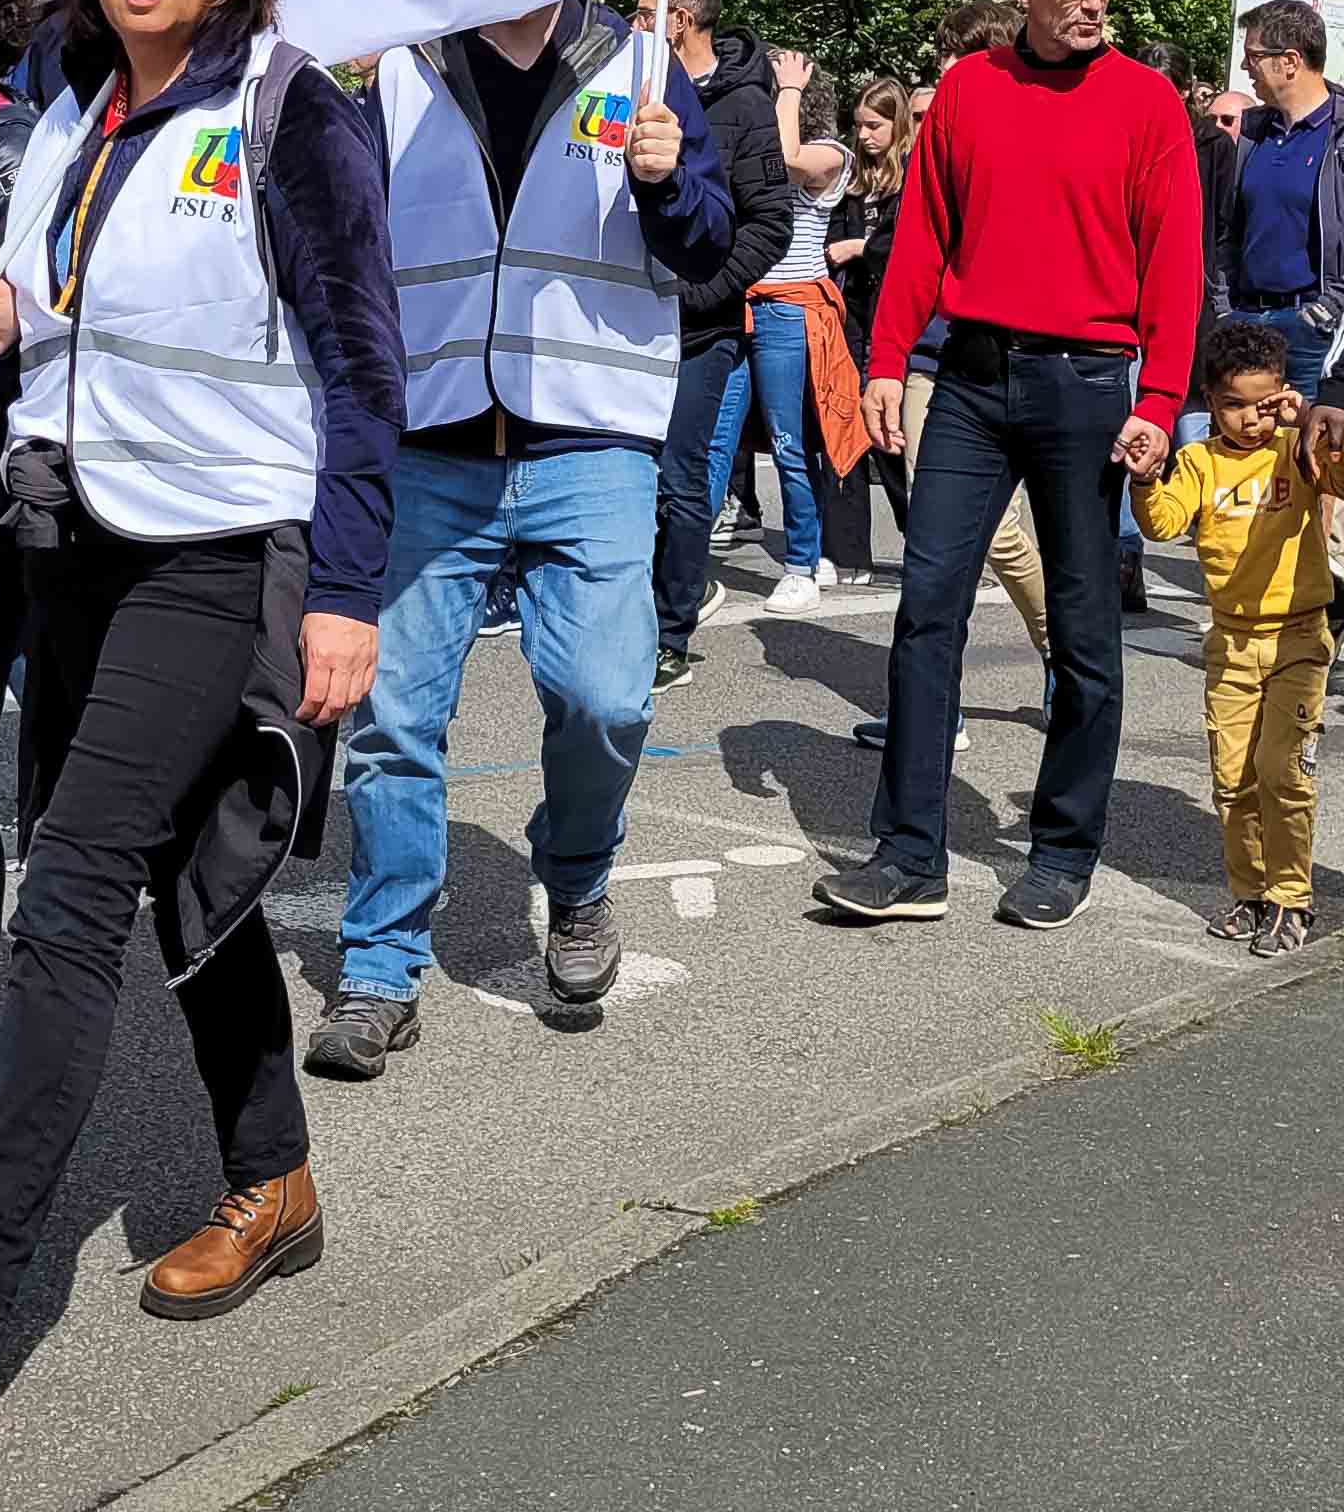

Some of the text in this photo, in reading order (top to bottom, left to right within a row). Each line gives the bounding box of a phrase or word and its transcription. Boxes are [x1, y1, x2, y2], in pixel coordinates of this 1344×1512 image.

[564, 142, 600, 162] FSU
[169, 196, 237, 224] FSU 8
[1213, 476, 1291, 511] CLUB
